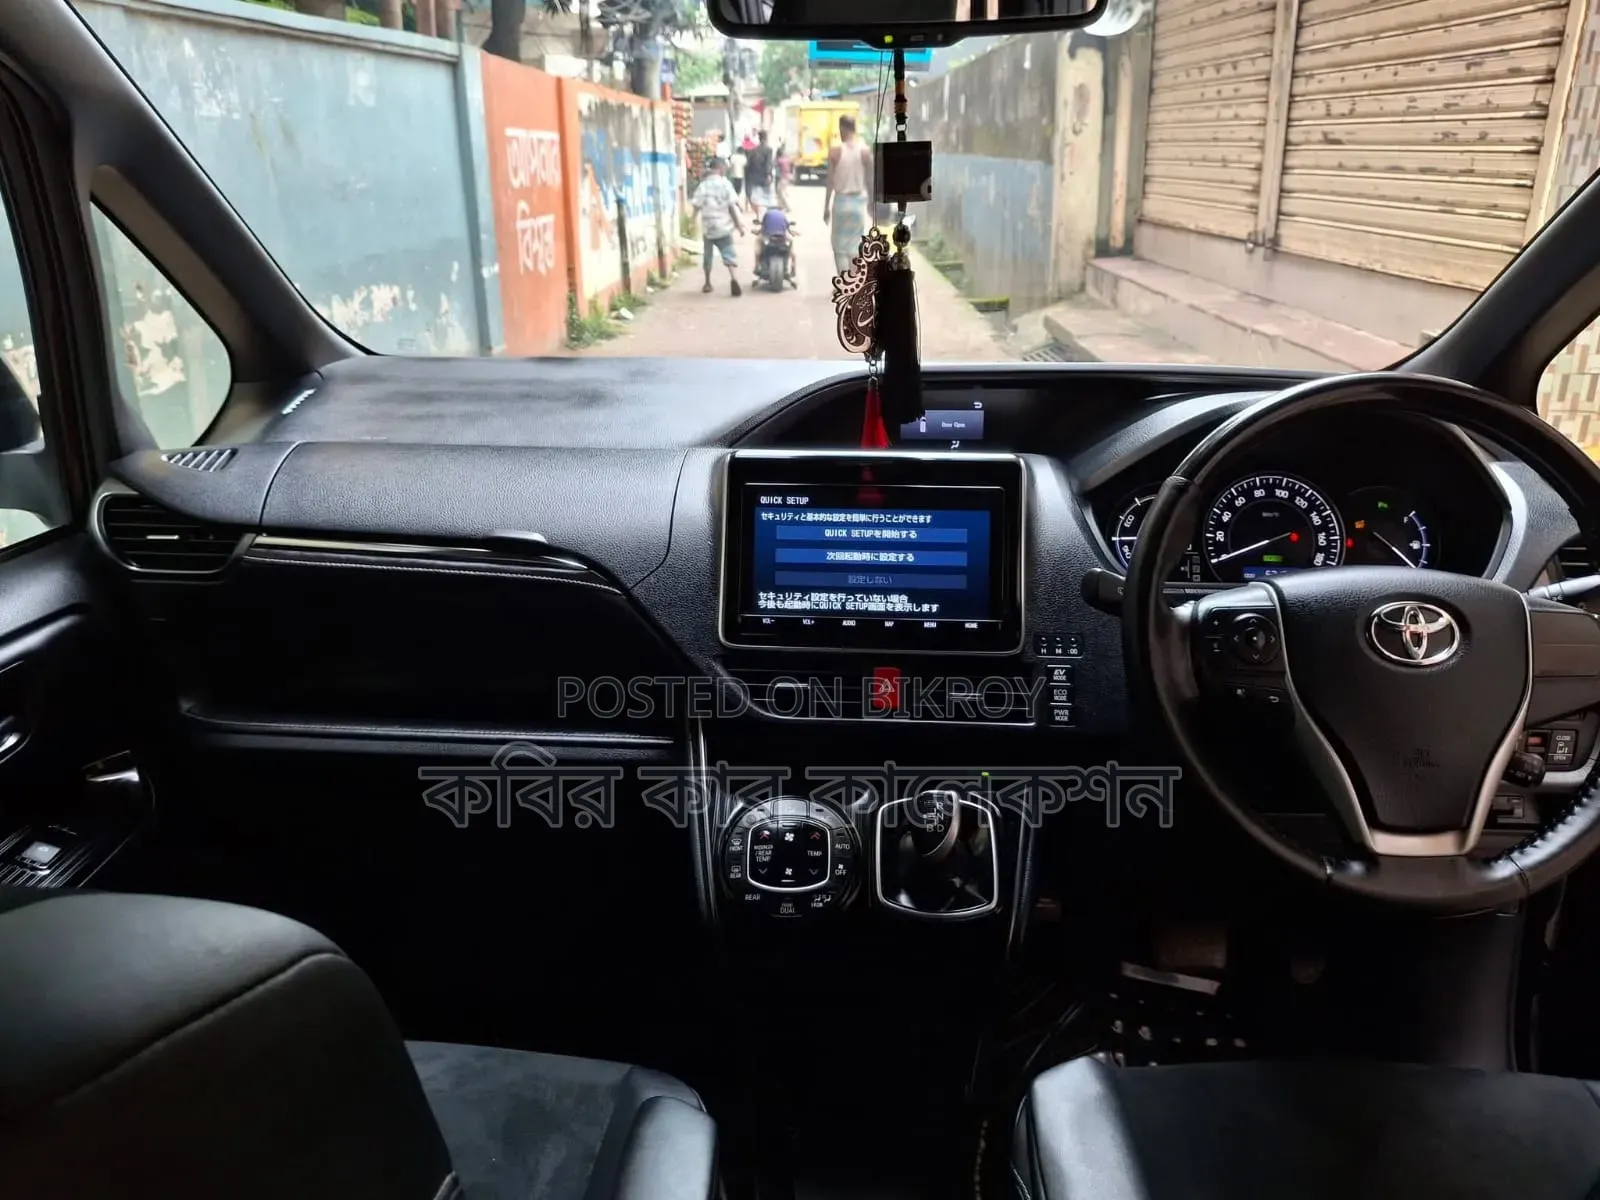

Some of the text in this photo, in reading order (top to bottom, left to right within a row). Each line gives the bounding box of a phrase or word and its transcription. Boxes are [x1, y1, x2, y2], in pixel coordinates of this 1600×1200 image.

[1254, 488, 1265, 498] 80
[1274, 488, 1289, 499] 100
[760, 495, 809, 505] QUICK SETUP
[1234, 496, 1246, 507] 60
[1294, 496, 1308, 509] 120
[1123, 514, 1135, 528] ECO
[1221, 511, 1232, 522] 40
[1309, 511, 1322, 526] 140
[824, 528, 918, 539] QUICK SETUPを開始する
[1216, 531, 1225, 542] 20
[1317, 531, 1327, 546] 160
[826, 551, 915, 562] 次回起動時に設定する
[1313, 552, 1325, 566] 180
[847, 575, 893, 585] 設定しない
[758, 592, 909, 603] セキュリティ設定を行っていない場合
[936, 801, 944, 810] R
[926, 823, 944, 832] B D
